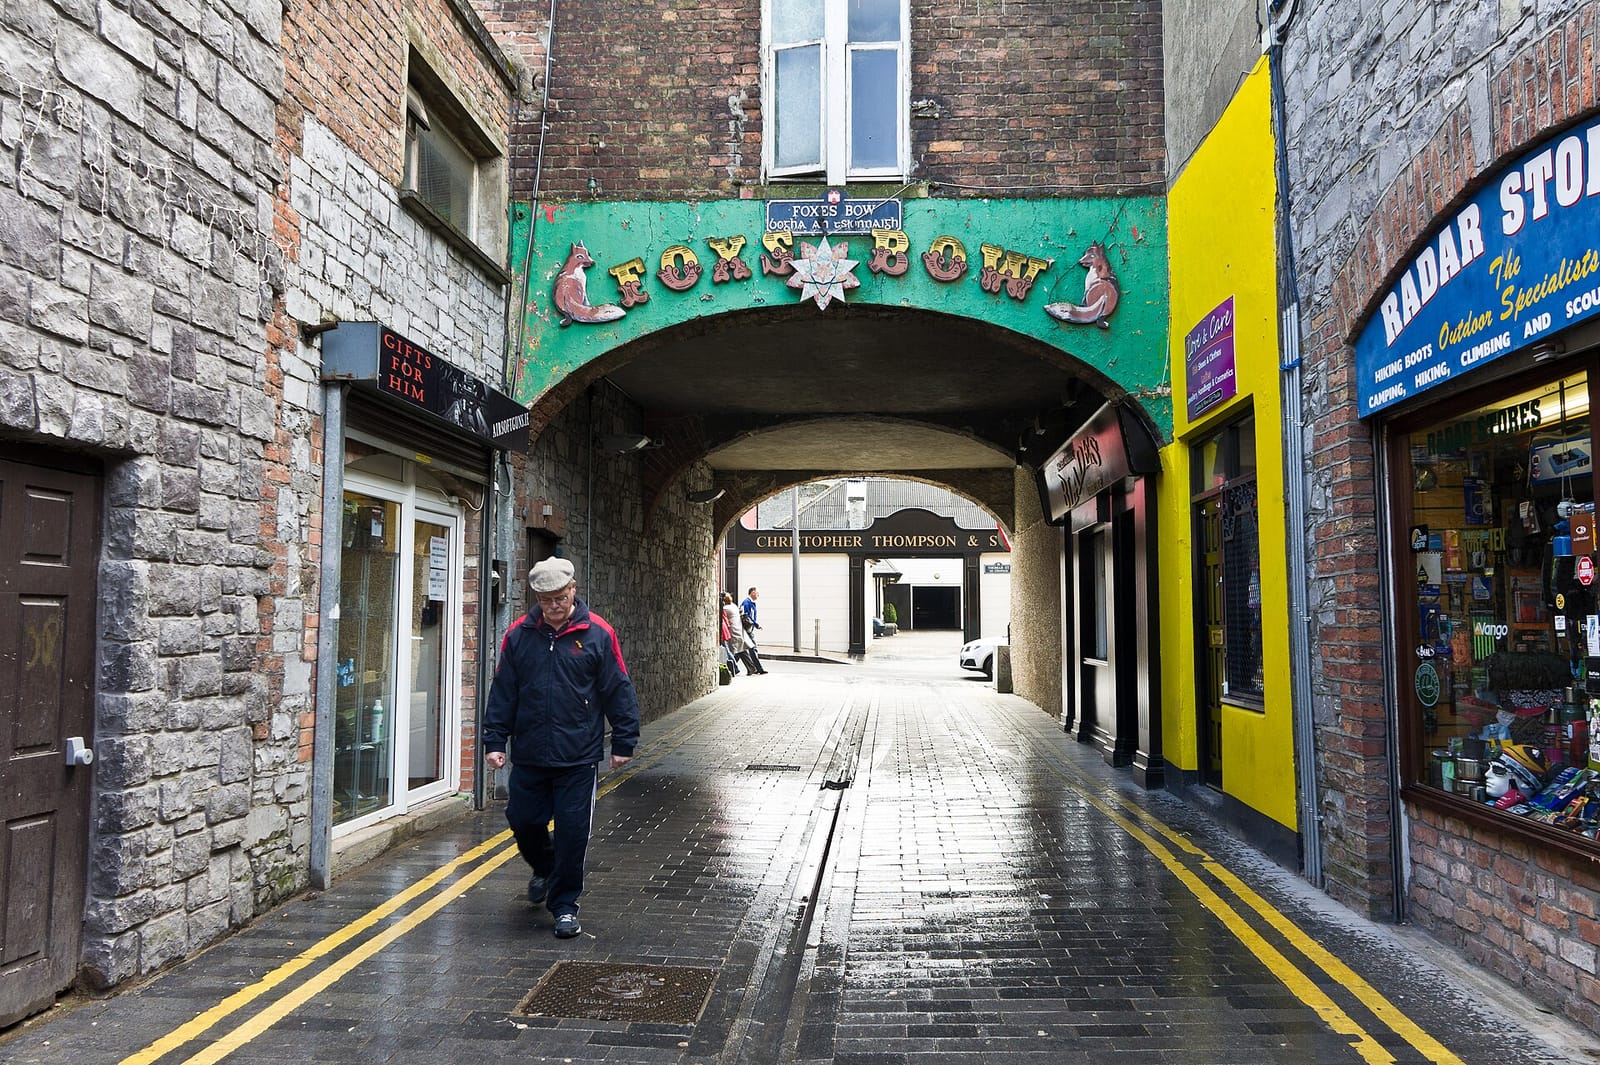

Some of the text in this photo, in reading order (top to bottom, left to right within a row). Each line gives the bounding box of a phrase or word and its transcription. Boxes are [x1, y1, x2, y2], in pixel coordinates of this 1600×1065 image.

[793, 205, 876, 217] FOXES BOW
[608, 229, 1051, 309] FOXS BOW
[1381, 203, 1486, 348] RADAR
[1489, 248, 1521, 290] The
[1438, 249, 1600, 350] Outdoor Specialists
[1209, 309, 1232, 339] Care
[383, 332, 433, 369] GIFTS
[1368, 382, 1406, 408] CAMPING,
[1414, 361, 1451, 388] HIKING,
[1460, 332, 1511, 366] CLIMBING
[1523, 312, 1551, 339] AND
[1375, 343, 1433, 383] HIKING BOOTS
[389, 374, 425, 403] HIM
[391, 356, 424, 384] FOR
[872, 535, 957, 547] THOMPSON
[967, 535, 979, 547] &
[1479, 622, 1508, 640] Vango
